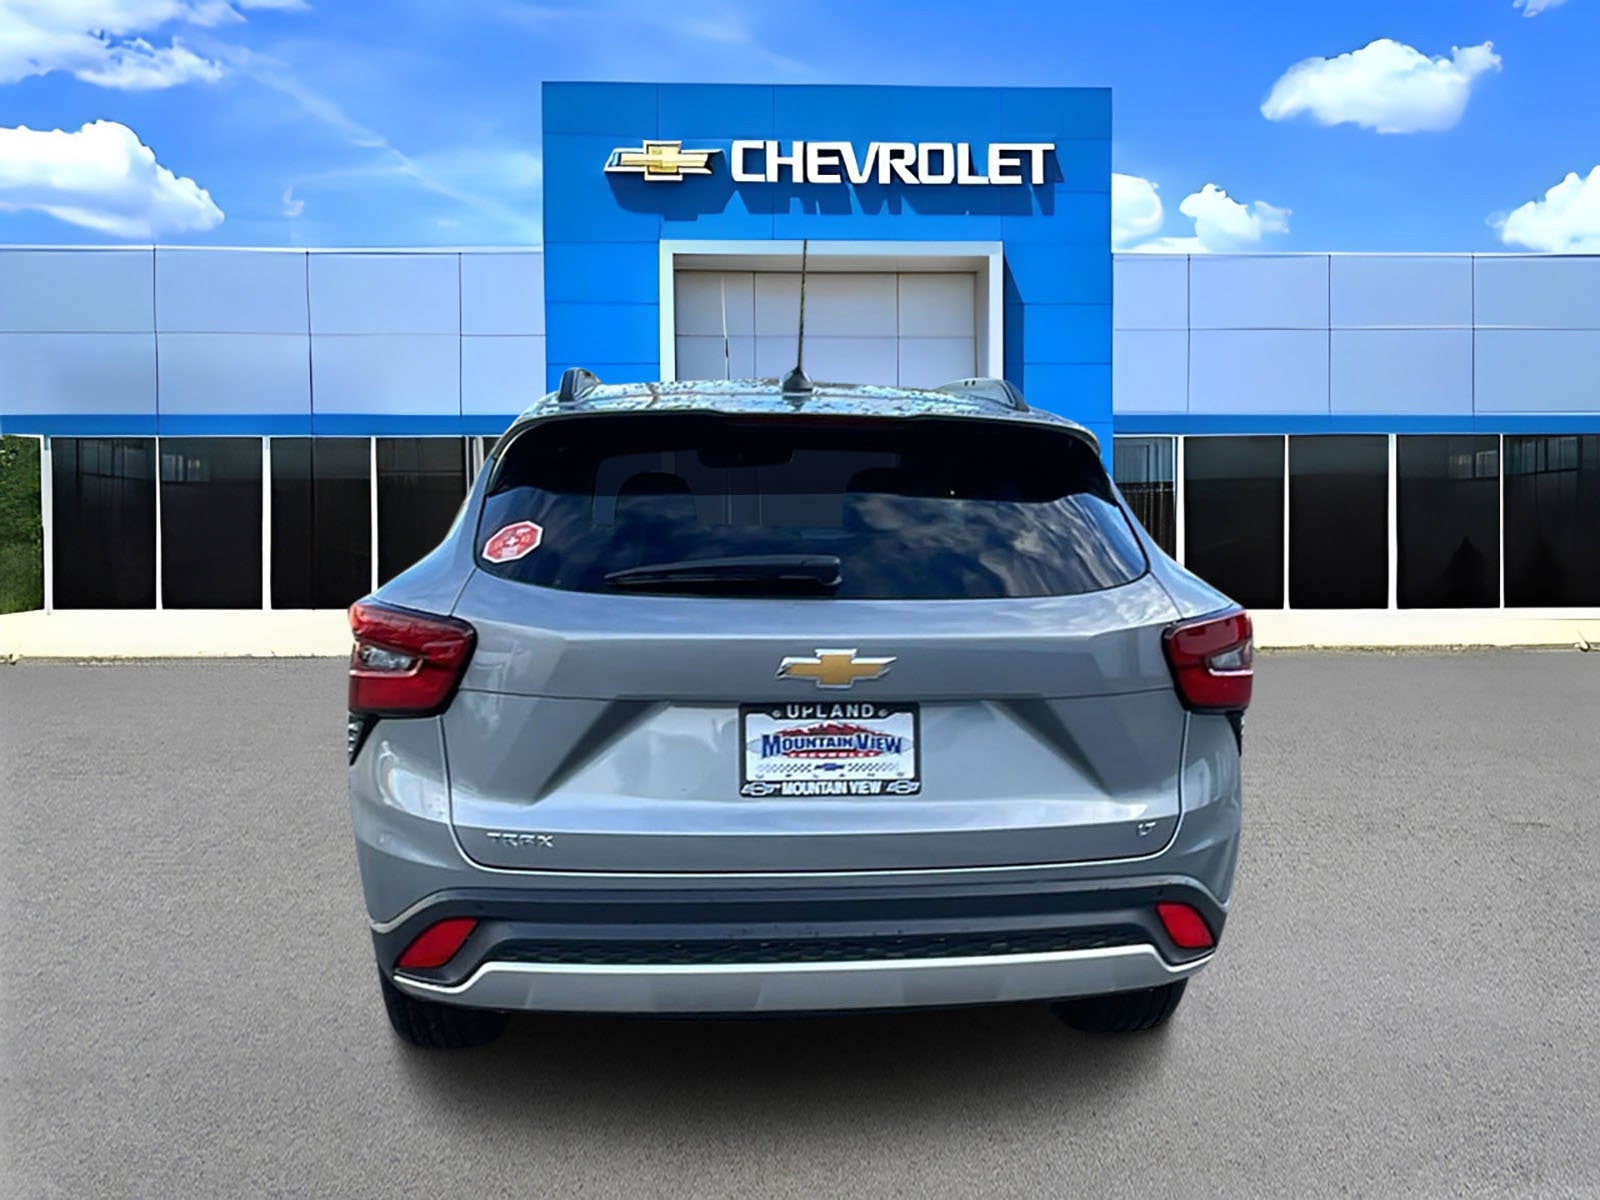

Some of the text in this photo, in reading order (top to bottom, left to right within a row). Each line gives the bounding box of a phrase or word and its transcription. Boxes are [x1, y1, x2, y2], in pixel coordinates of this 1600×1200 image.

[731, 140, 1055, 184] CHEVROLET
[786, 704, 874, 718] UPLAND
[762, 734, 902, 758] MOUNTAIN VIEW
[781, 781, 882, 795] MOUNTAIN VIEW
